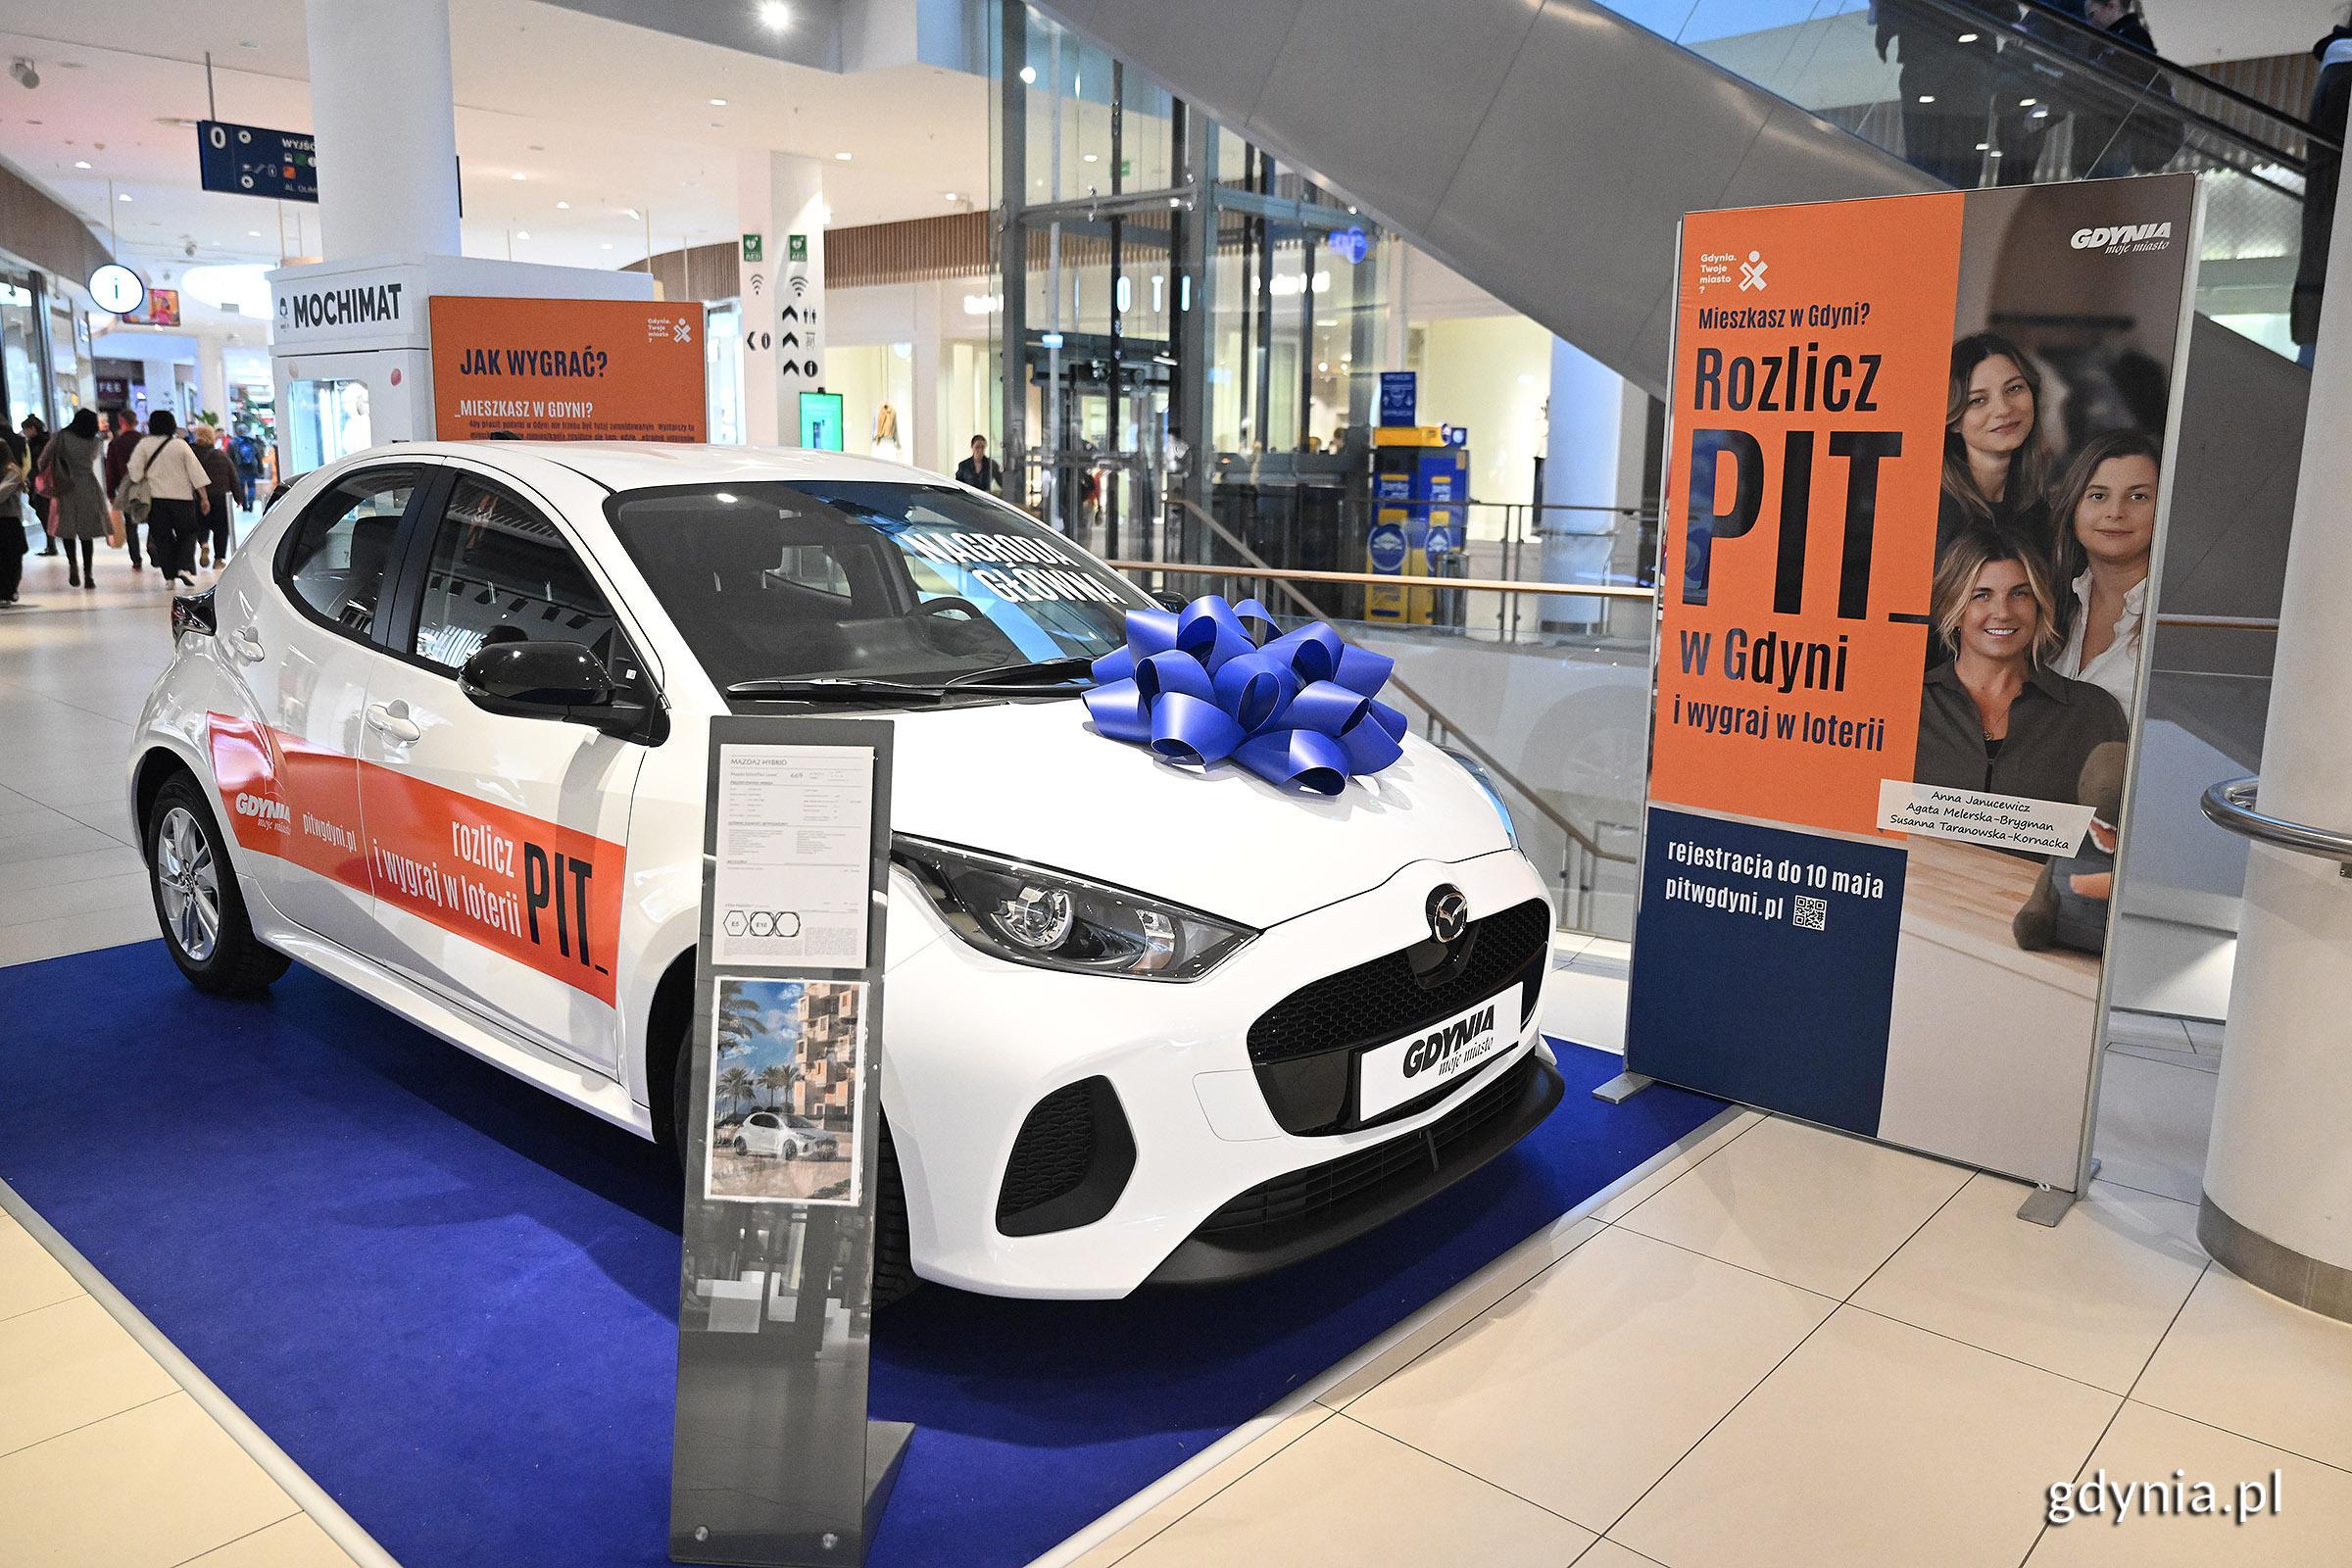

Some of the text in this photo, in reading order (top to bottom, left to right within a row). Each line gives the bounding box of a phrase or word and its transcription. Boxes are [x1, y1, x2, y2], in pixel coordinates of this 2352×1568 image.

[2070, 221, 2172, 250] GDYNIA
[2104, 240, 2170, 256] moje miasto
[1700, 253, 1737, 264] Gdynia.
[1700, 264, 1728, 274] Twoje
[293, 283, 402, 328] MOCHIMAT
[1698, 302, 1870, 329] Mieszkasz w Gdyni?
[460, 345, 608, 378] JAK WYGRAĆ?
[1694, 342, 1883, 413] Rozlicz
[533, 401, 545, 417] W
[548, 401, 594, 418] GDYNI?
[898, 532, 1081, 567] NAGRODA
[971, 560, 1129, 605] GŁÓWNA
[1680, 627, 1849, 694] w Gdyni
[1673, 694, 1885, 752] i wygraj w loterii
[235, 792, 291, 823] GDYNIA
[1906, 802, 2054, 832] Agata Melerska-Brygman
[1931, 791, 2031, 812] Anna Janucewicz
[302, 811, 358, 854] pitwgdyni.pl
[452, 820, 514, 878] rozlicz
[1890, 814, 2069, 850] Susanna Taranowska-Kornacka
[372, 838, 522, 938] i wygraj w loterii
[1668, 841, 1885, 900] rejestracja do 10 maja
[1665, 876, 1784, 920] pitwgdyni.pl
[1402, 1004, 1495, 1079] GDYNIA
[1439, 1035, 1494, 1076] moje miasto
